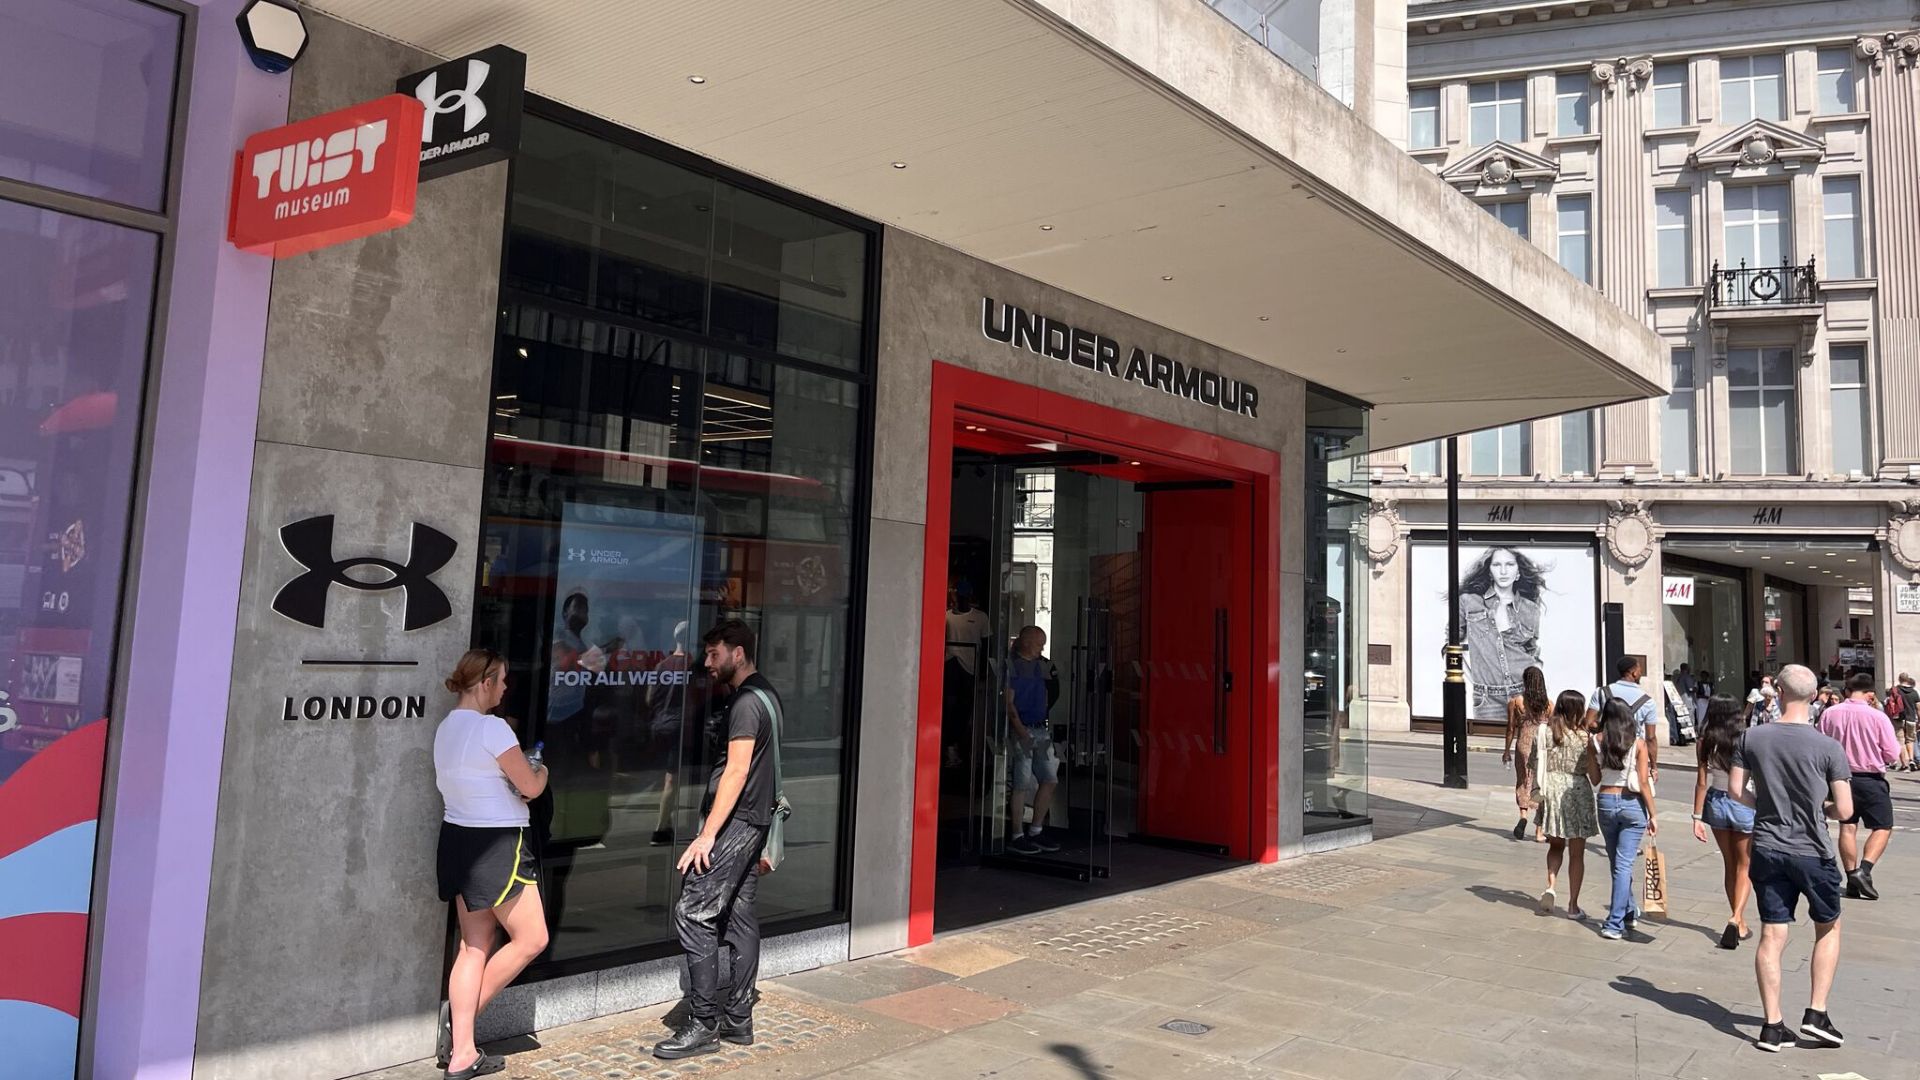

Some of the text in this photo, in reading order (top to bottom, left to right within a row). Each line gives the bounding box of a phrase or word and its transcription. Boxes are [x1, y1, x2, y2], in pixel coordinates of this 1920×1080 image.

[420, 132, 490, 162] DER ARMOUR
[274, 186, 350, 220] museum
[982, 296, 1259, 418] UNDER ARMOUR
[1487, 505, 1514, 521] H&M
[1752, 507, 1782, 524] H&M
[590, 549, 622, 558] UNDER
[590, 556, 629, 567] ARMOUR
[1665, 583, 1691, 599] H&M
[554, 670, 693, 686] FOR ALL WE GET
[282, 695, 426, 721] LONDON
